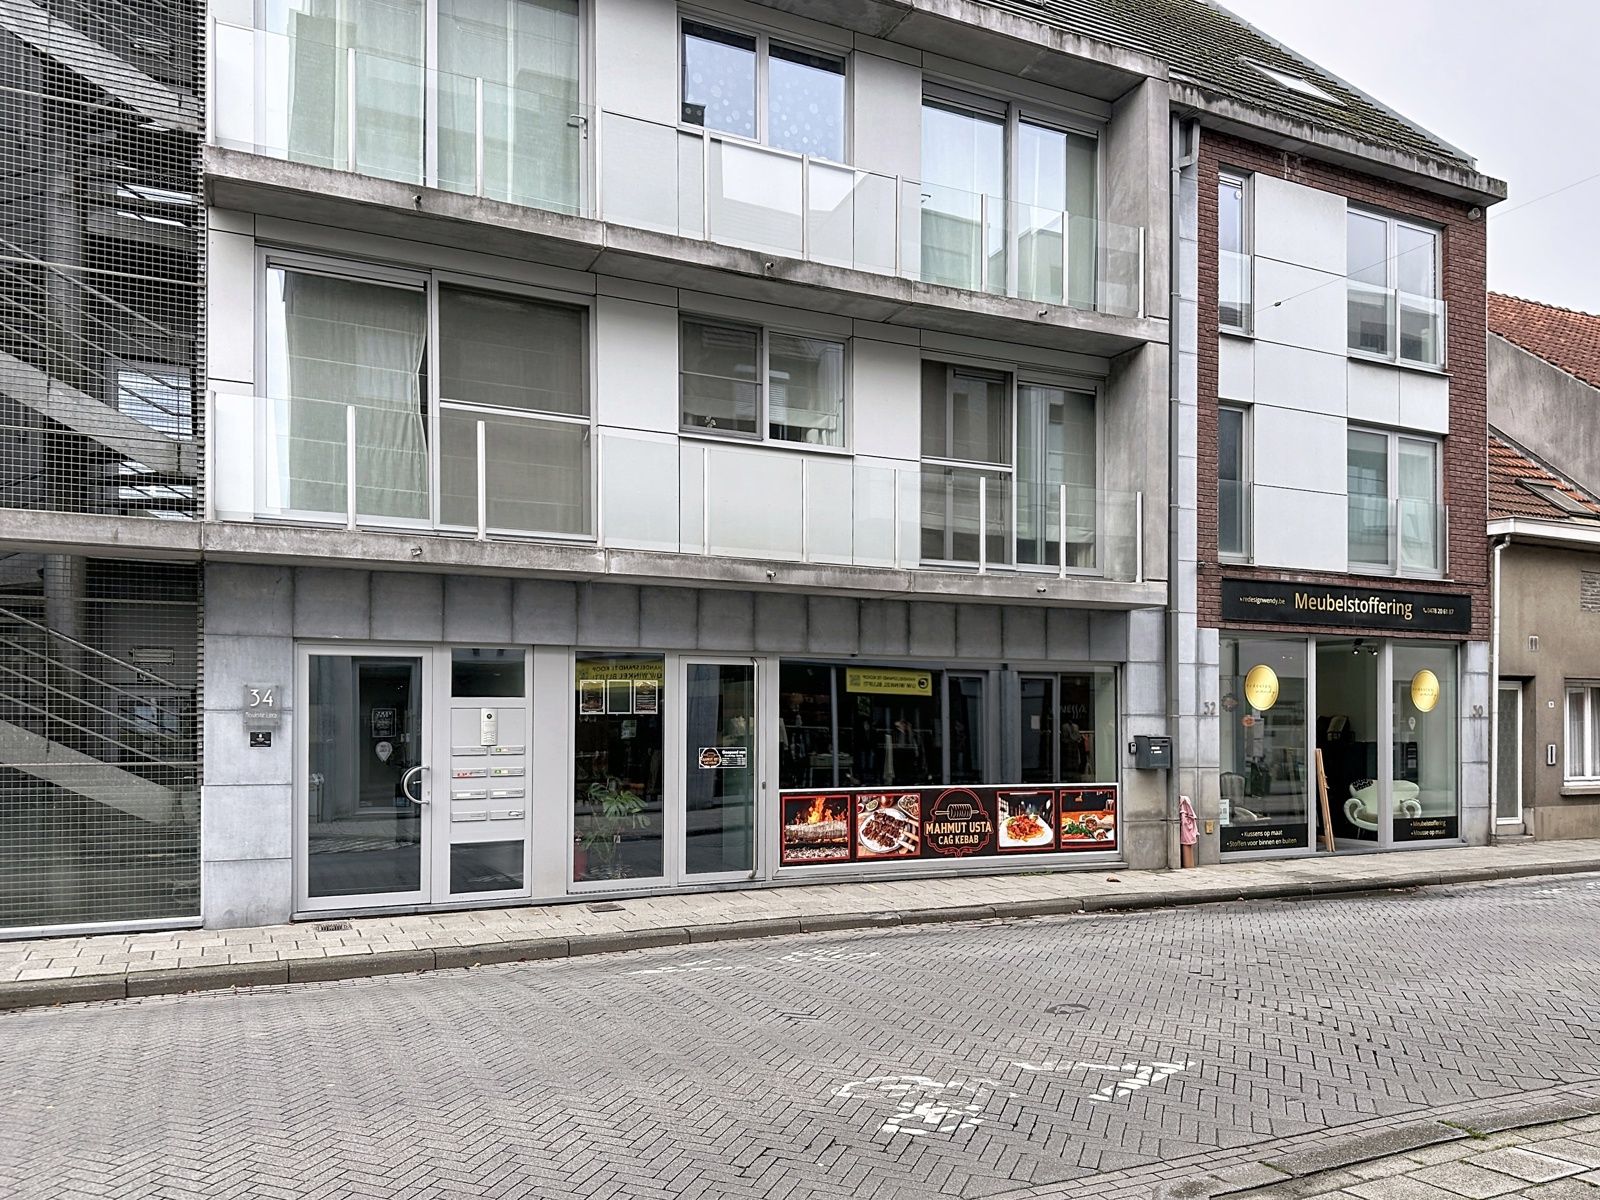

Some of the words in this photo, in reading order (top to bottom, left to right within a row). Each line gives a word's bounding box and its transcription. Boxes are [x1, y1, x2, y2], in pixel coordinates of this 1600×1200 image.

[1295, 592, 1413, 621] Meubelstoffering
[249, 689, 274, 707] 34
[925, 821, 967, 835] MAHMUT
[969, 820, 992, 833] USTA
[1264, 830, 1271, 838] op
[955, 834, 979, 844] KEBAB
[1229, 840, 1247, 848] Stoffen
[1258, 838, 1275, 846] binnen
[1282, 837, 1298, 845] buiten
